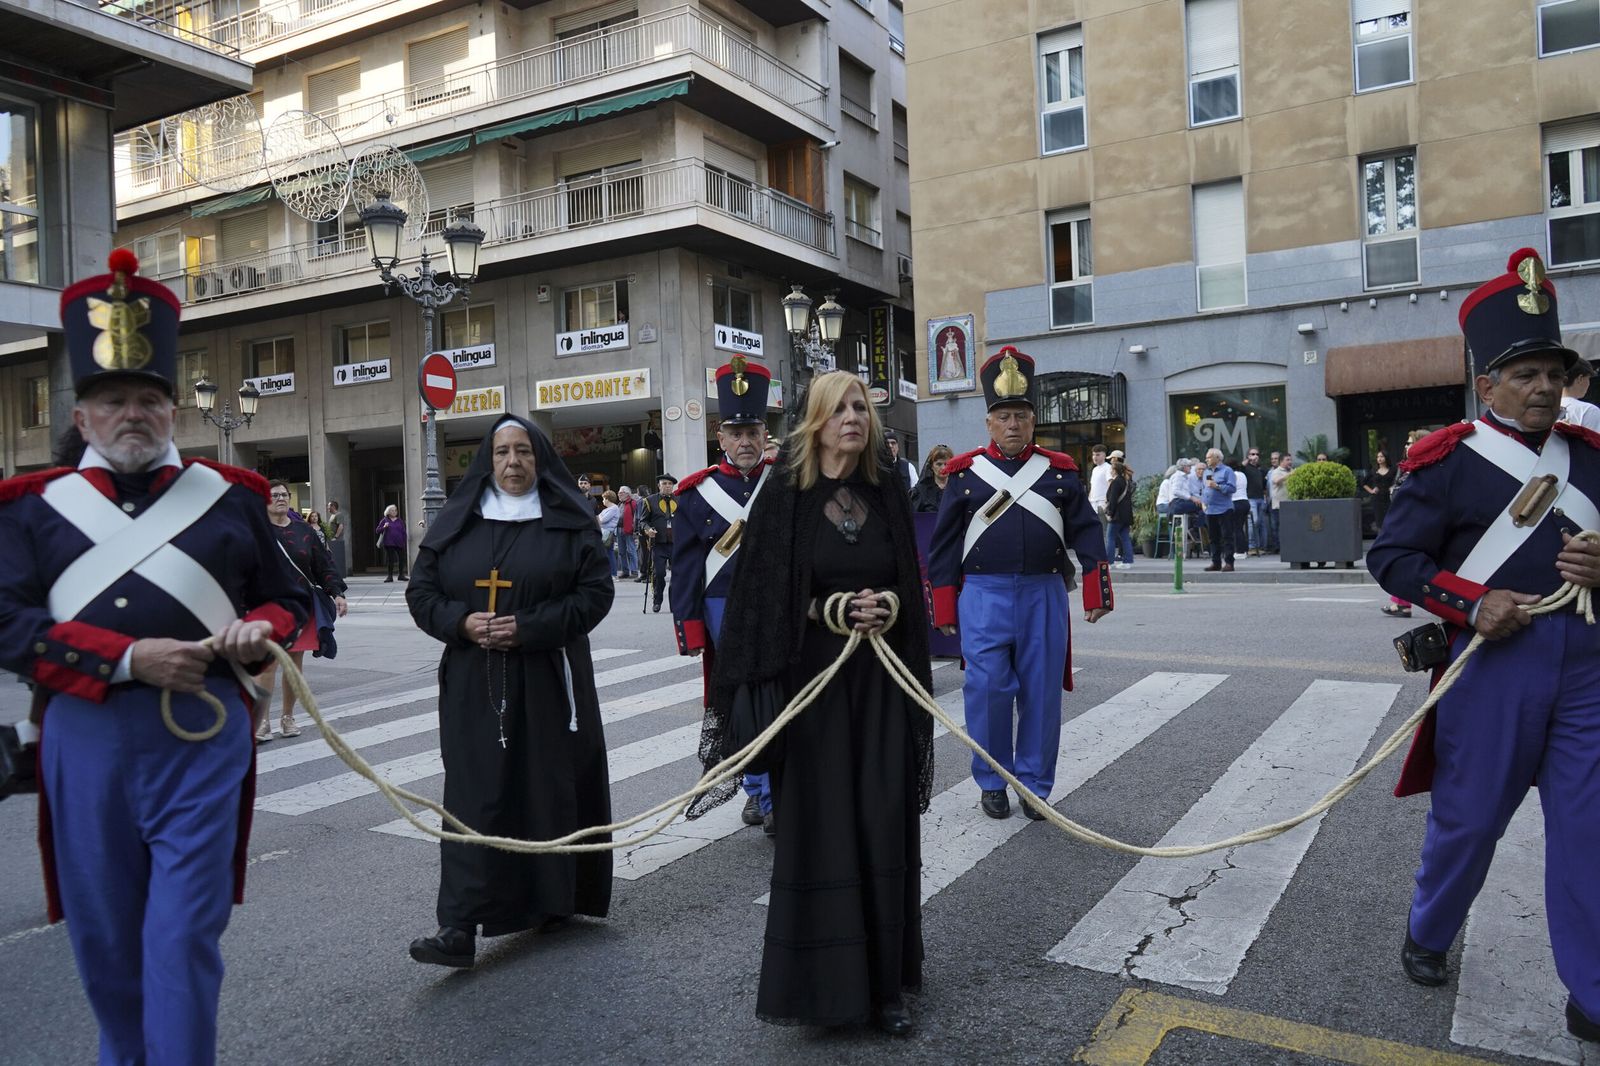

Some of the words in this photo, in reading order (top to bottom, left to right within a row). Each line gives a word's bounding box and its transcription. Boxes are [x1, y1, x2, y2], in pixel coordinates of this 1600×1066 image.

[581, 331, 625, 345] inlingua
[732, 330, 761, 350] inlingua
[453, 350, 492, 364] inlingua
[352, 364, 387, 378] inlingua
[260, 377, 292, 390] inlingua
[539, 376, 631, 404] RISTORANTE
[443, 388, 501, 415] IZZERIA
